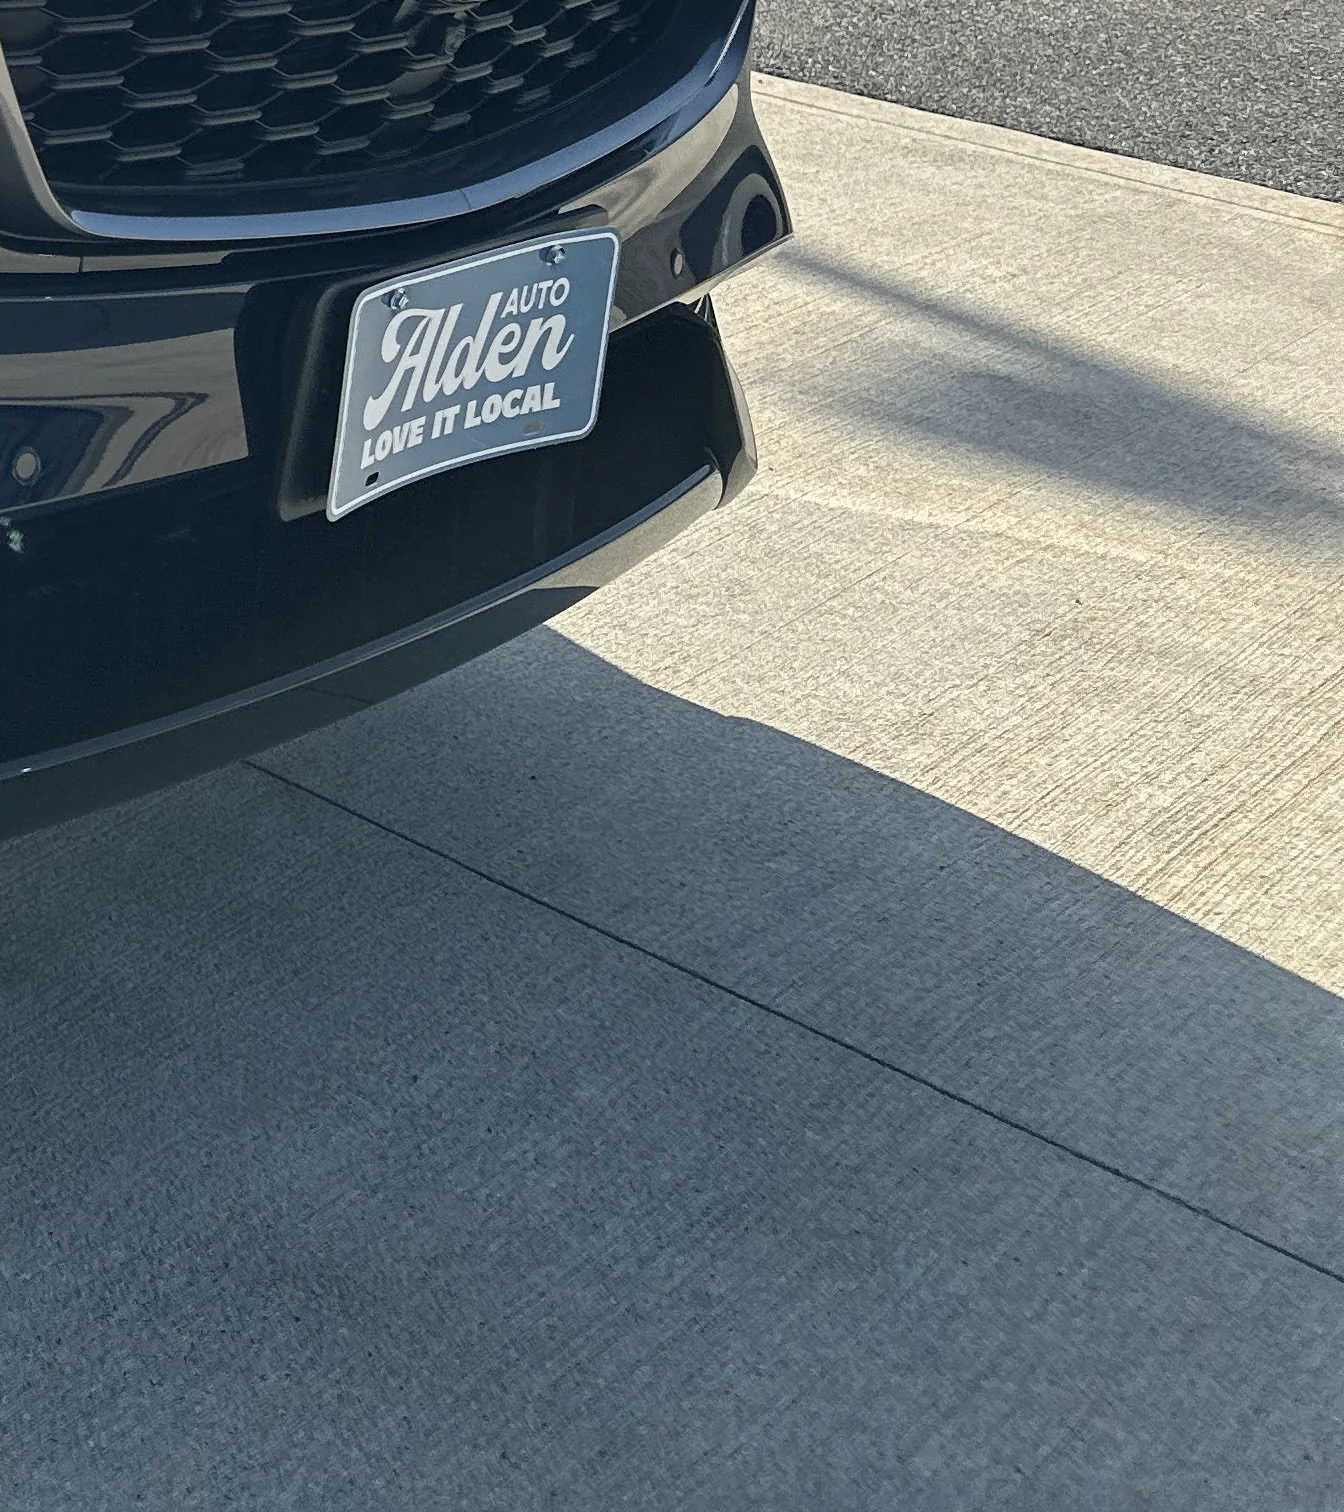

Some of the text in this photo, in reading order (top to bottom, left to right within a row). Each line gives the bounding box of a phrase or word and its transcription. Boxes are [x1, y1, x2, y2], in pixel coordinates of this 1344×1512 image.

[501, 277, 570, 318] AUTO
[363, 292, 575, 430] Alden
[360, 382, 560, 469] LOVE IT LOCAL
